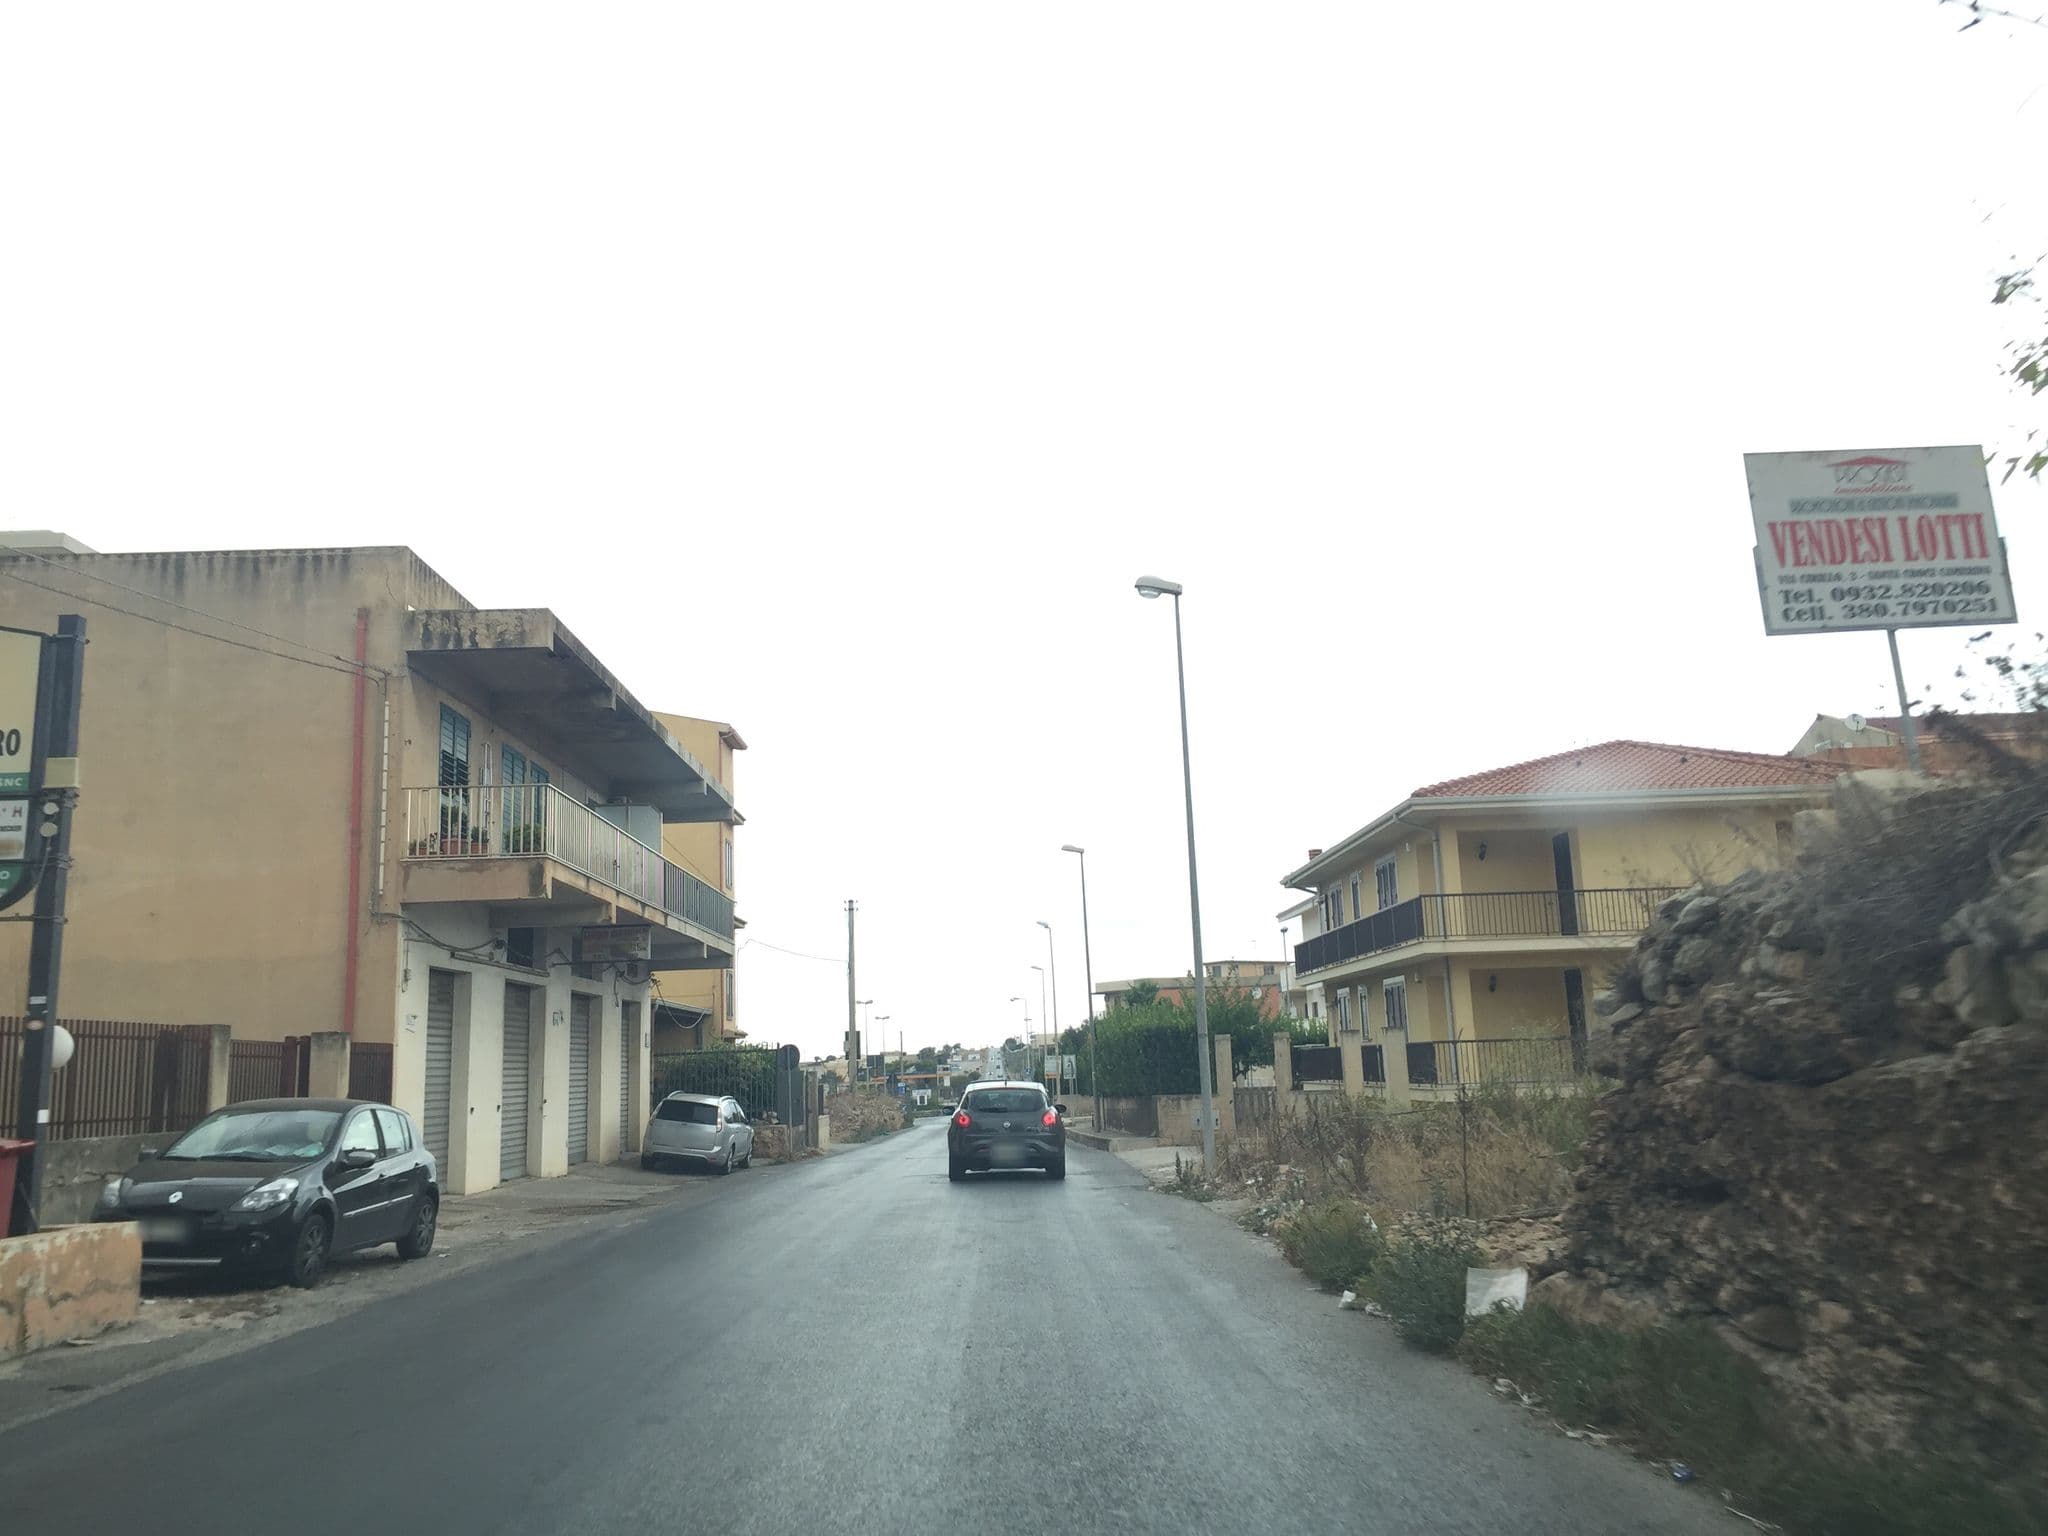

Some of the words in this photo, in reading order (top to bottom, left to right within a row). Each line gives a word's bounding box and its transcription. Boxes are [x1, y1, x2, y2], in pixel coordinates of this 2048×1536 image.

[1767, 517, 1894, 568] VENDESI
[1897, 512, 1991, 562] LOTTI
[1778, 588, 1823, 604] Tel.
[1782, 605, 1834, 622] Cell.
